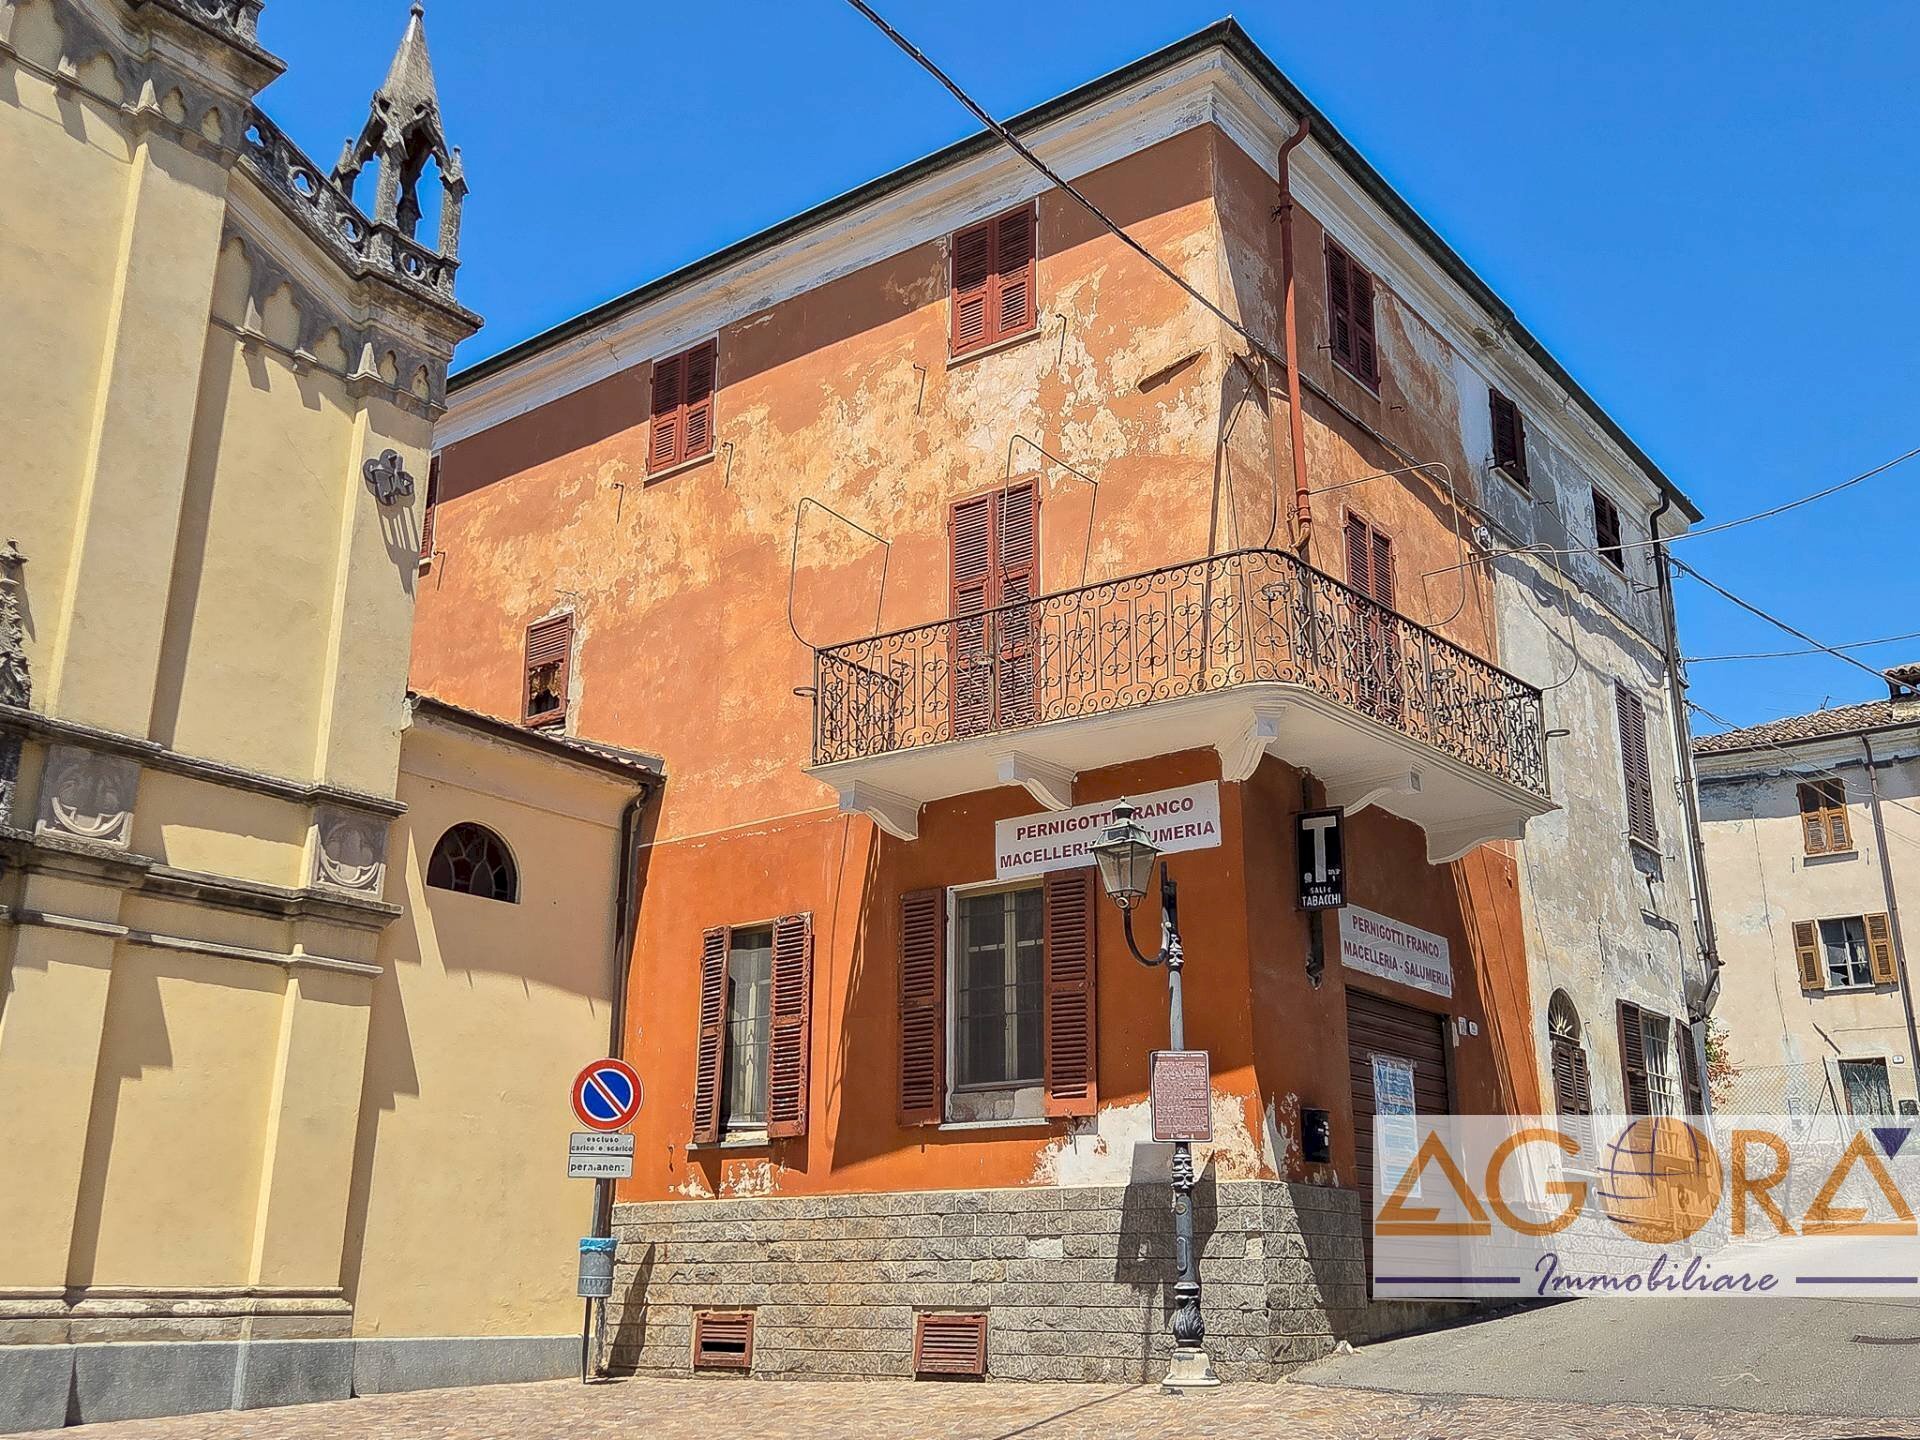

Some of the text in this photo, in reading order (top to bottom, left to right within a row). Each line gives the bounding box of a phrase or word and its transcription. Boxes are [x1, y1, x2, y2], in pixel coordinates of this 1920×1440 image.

[1017, 797, 1194, 841] PERNIGOTTI RANCO
[1000, 820, 1216, 869] MACELLERI UMERIA
[1302, 815, 1337, 883] T
[1302, 893, 1341, 907] TABACCHI
[1352, 915, 1440, 958] PERNIGOTTI FRANCO
[1344, 940, 1399, 971] MACELLERIA
[1404, 960, 1450, 987] SALUMERIA
